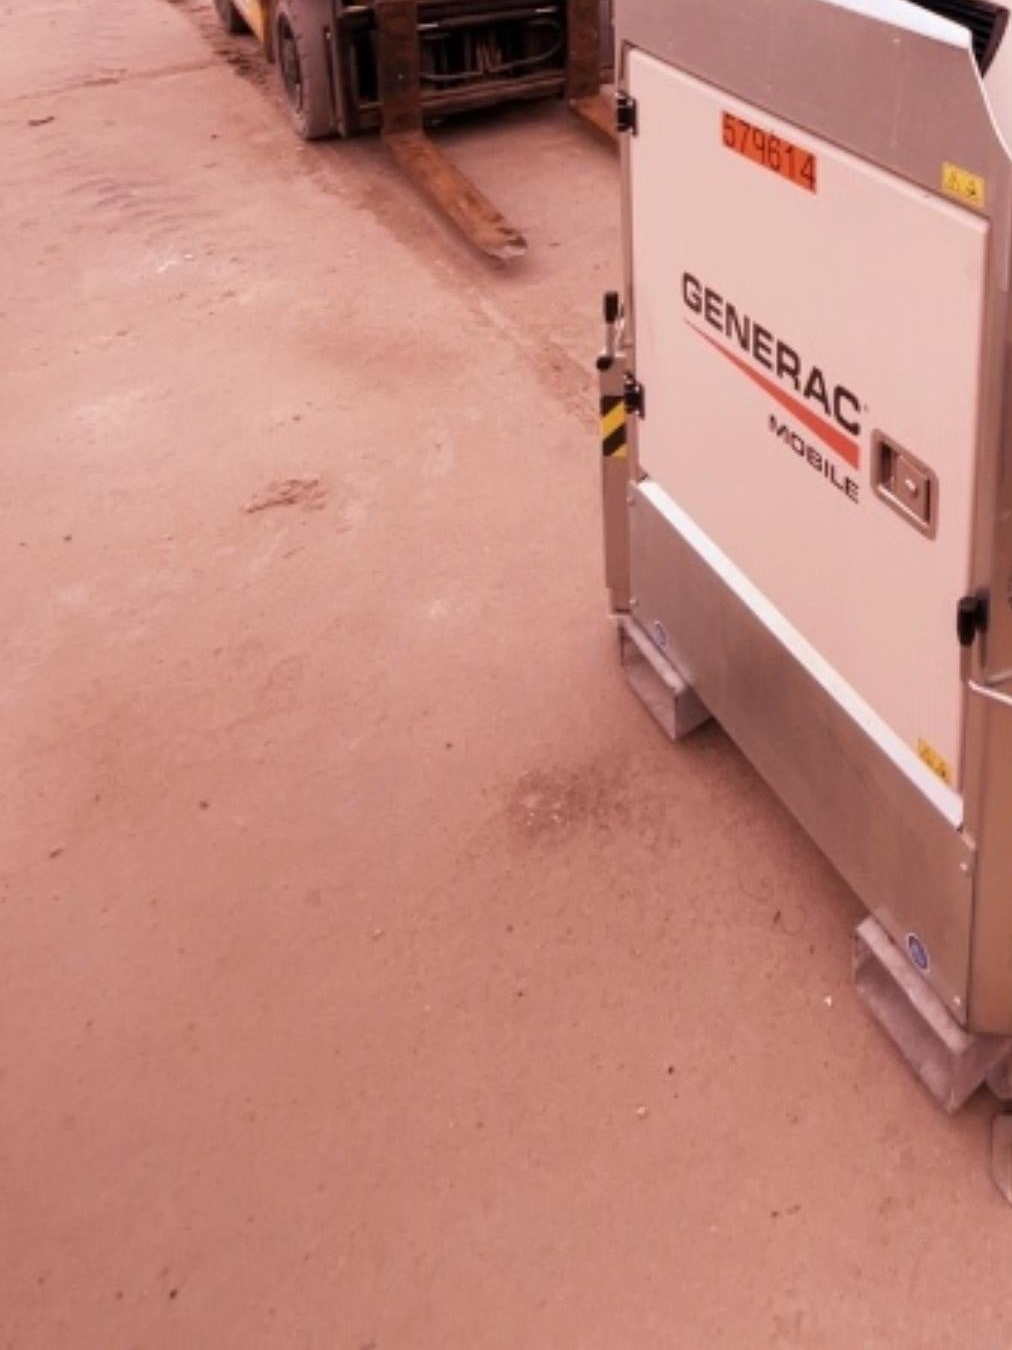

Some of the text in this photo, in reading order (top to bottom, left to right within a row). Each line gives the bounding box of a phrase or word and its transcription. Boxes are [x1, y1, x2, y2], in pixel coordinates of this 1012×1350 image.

[723, 111, 817, 194] 579614
[681, 271, 862, 436] GENERAC
[768, 413, 859, 505] MOBILE
